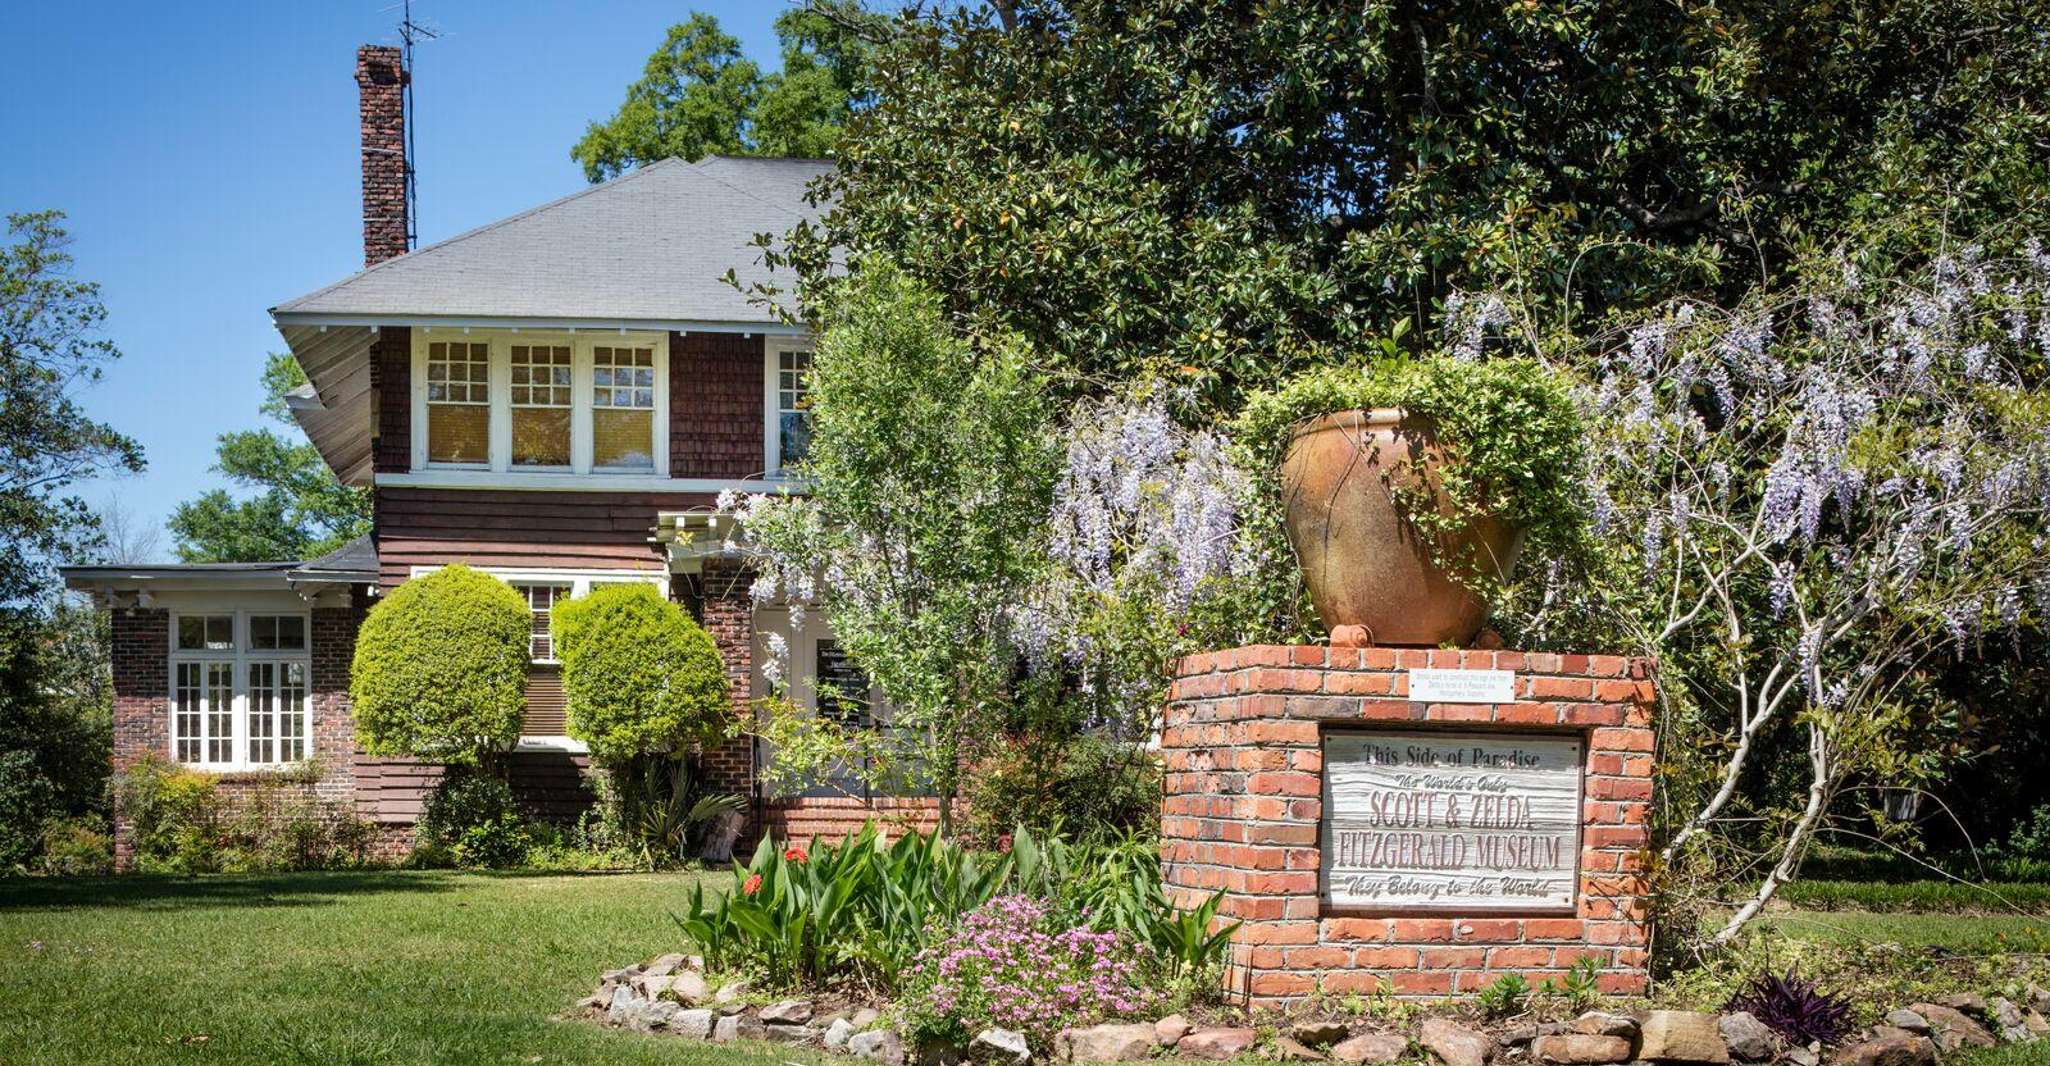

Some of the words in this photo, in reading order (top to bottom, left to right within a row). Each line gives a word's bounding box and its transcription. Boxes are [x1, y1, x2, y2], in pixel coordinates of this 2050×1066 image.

[1363, 744, 1398, 766] This
[1407, 745, 1439, 767] Side
[1447, 748, 1464, 767] of
[1472, 747, 1540, 769] Paradise
[1395, 774, 1418, 788] The
[1370, 790, 1437, 828] SCOTT
[1446, 793, 1461, 829] &
[1470, 794, 1534, 831] ZELDA
[1338, 831, 1466, 870] FITZGERALD
[1473, 834, 1560, 872] MUSEUM
[1344, 875, 1382, 899] They
[1387, 875, 1441, 900] Belong
[1446, 879, 1462, 897] to
[1468, 877, 1494, 895] the
[1500, 876, 1552, 898] World
